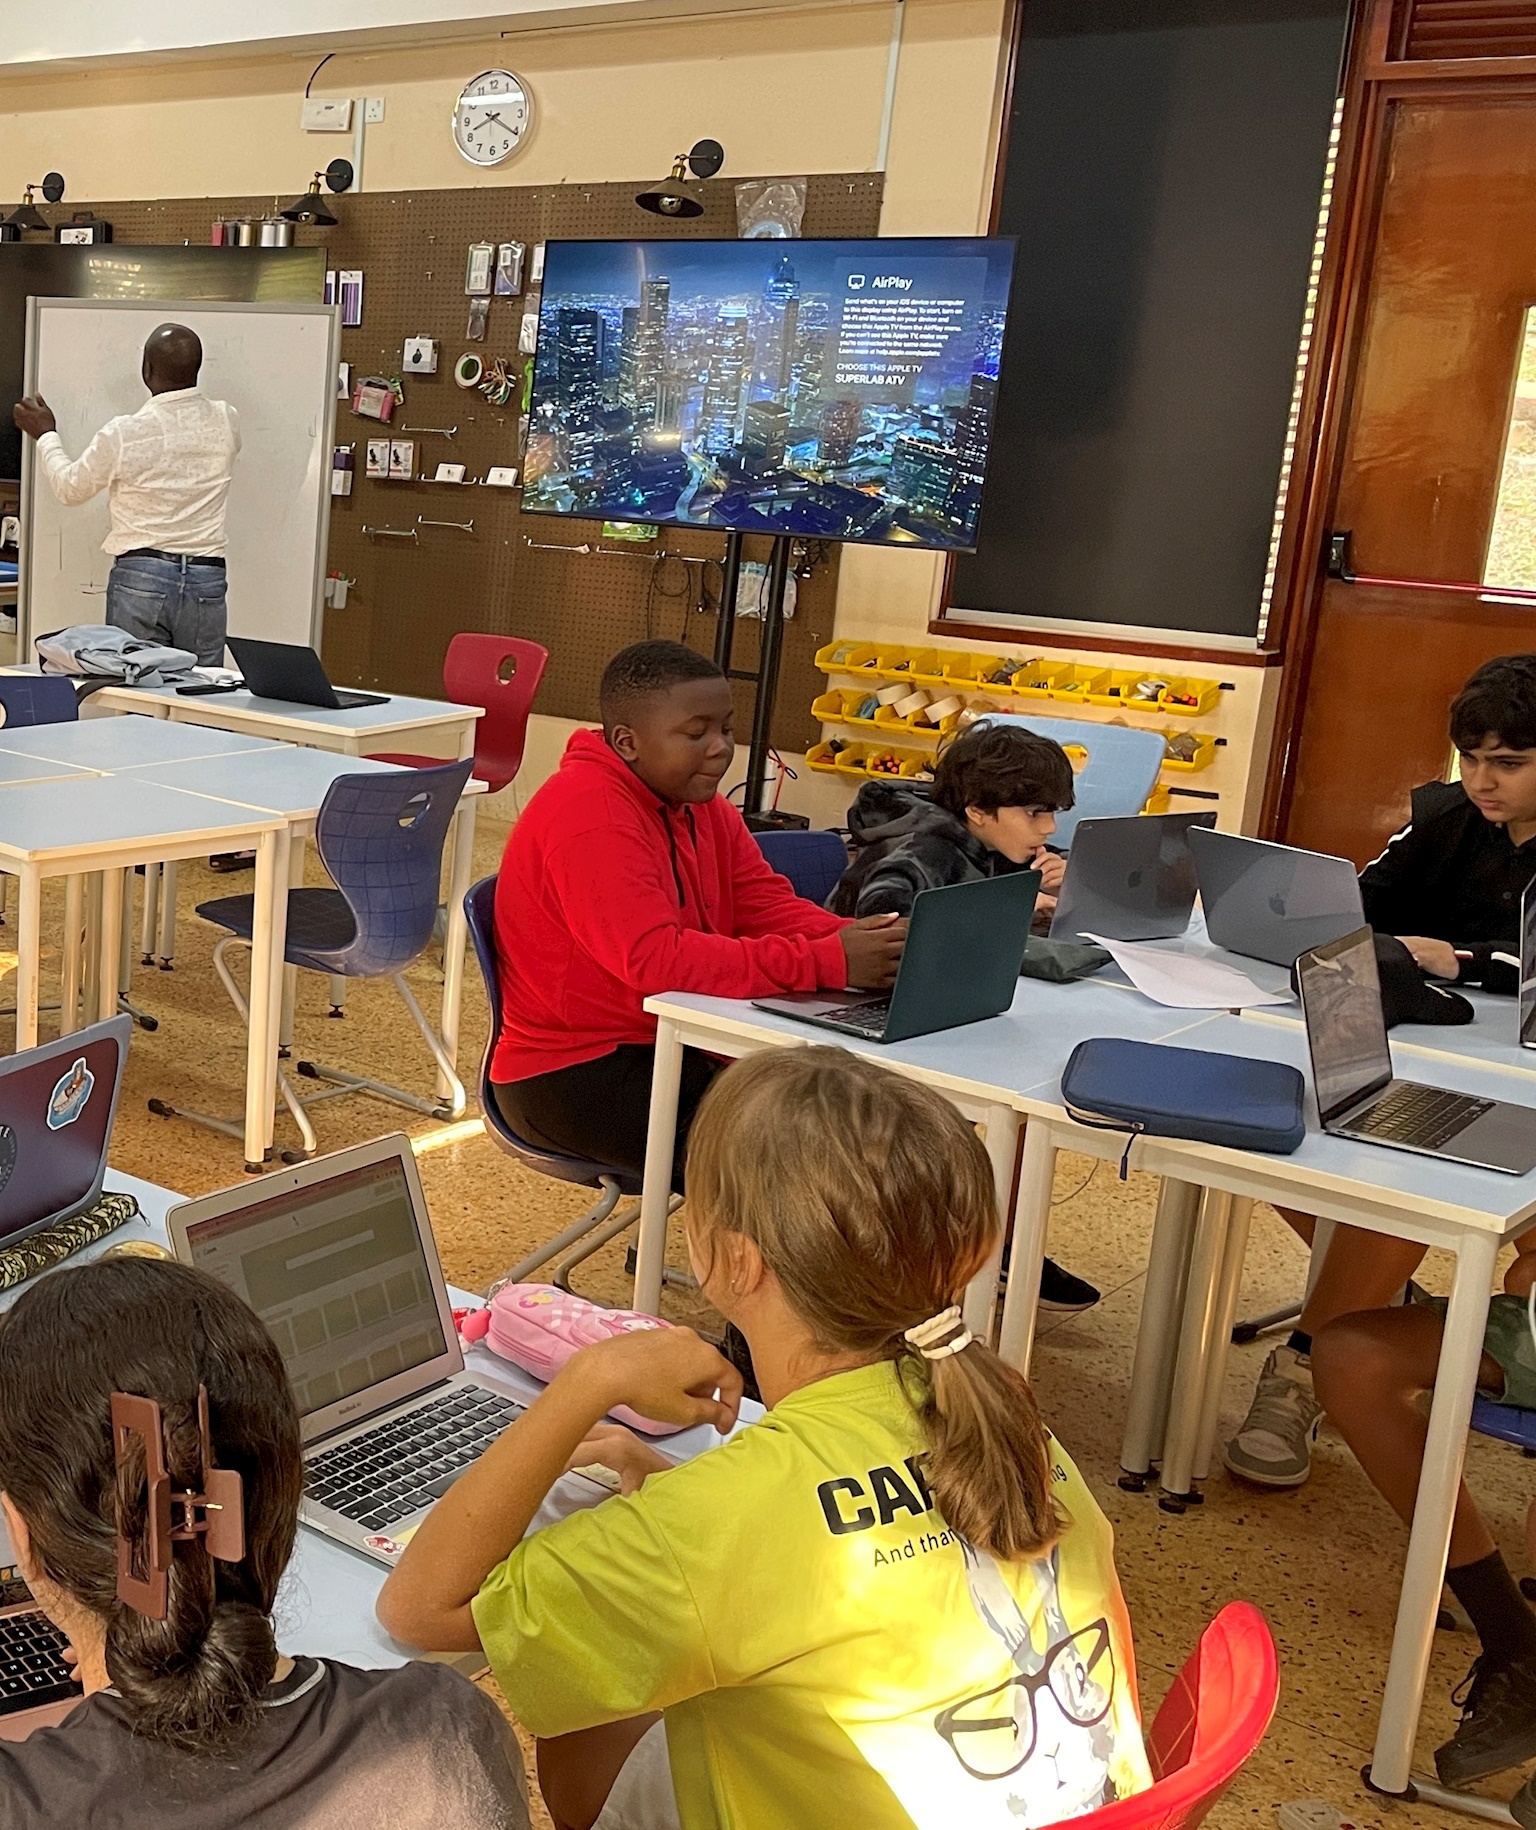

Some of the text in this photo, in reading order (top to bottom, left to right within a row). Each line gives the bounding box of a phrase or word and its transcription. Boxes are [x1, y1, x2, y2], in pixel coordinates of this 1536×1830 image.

[489, 79, 499, 90] 12
[477, 86, 486, 96] 11
[516, 108, 524, 119] 3
[464, 117, 471, 127] 9
[466, 132, 474, 143] 8
[476, 143, 483, 153] 7
[502, 139, 510, 150] 5
[489, 145, 496, 156] 6
[871, 276, 913, 291] AirPlay
[836, 363, 923, 373] CHOOSE THIS APPLE TV
[834, 373, 906, 385] SUPERLAB ATV
[874, 1539, 916, 1568] And
